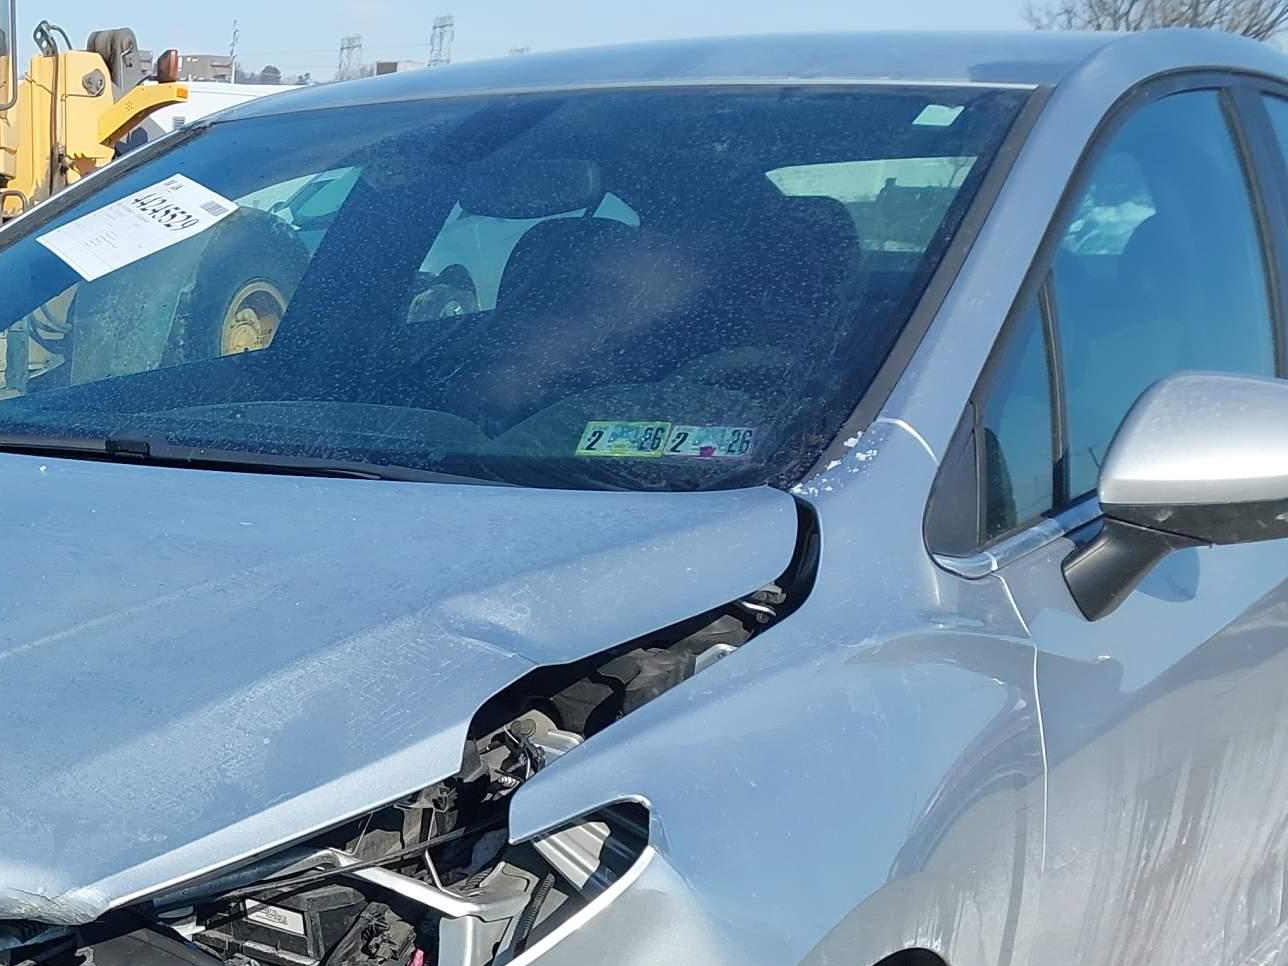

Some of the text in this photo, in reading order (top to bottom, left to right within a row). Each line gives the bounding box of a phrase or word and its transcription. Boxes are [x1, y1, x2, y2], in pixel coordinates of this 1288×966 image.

[130, 192, 200, 231] 44245529
[585, 430, 604, 450] 2
[670, 429, 753, 454] 2 26
